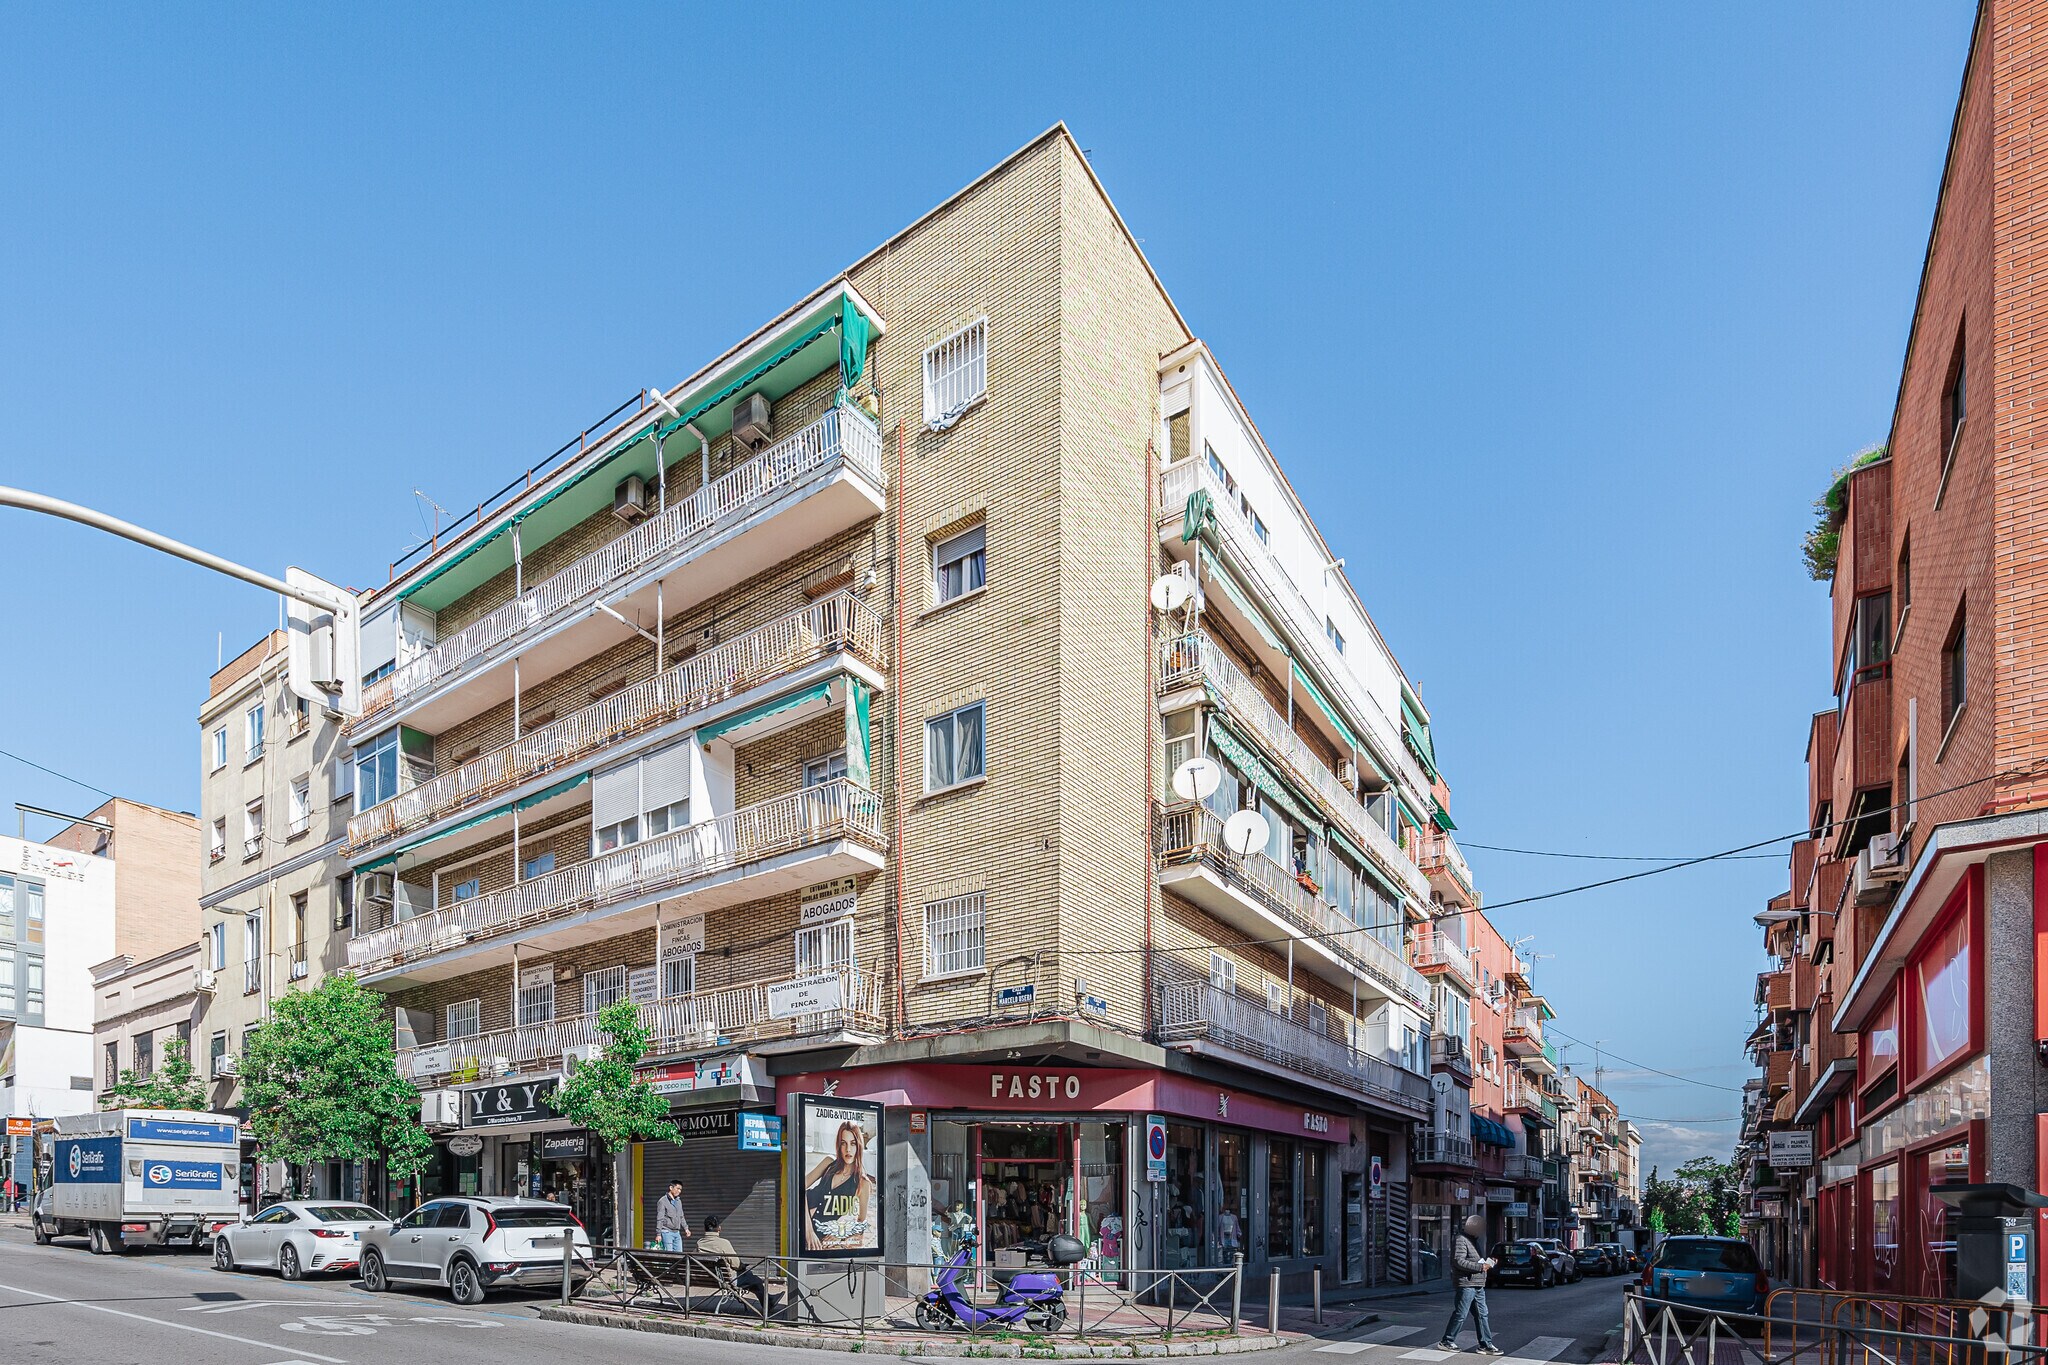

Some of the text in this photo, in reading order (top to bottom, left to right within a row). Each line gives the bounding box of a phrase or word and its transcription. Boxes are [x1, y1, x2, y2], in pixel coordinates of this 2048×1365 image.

[803, 897, 855, 919] ABOGADOS
[671, 934, 690, 943] FINCAS
[662, 941, 701, 958] ABOGADOS
[770, 974, 838, 993] ADMINISTRACIÓN
[790, 999, 818, 1009] FINCAS
[1000, 994, 1032, 1004] MARCELO USERA
[991, 1074, 1080, 1099] FASTO
[471, 1090, 488, 1114] Y
[496, 1088, 513, 1112] &
[522, 1084, 539, 1109] Y
[745, 1118, 780, 1130] REPARAMOS
[1304, 1112, 1328, 1133] FASTO
[156, 1127, 210, 1136] www.serigrafic.net
[752, 1130, 759, 1139] TU
[544, 1136, 584, 1149] Zapatería
[82, 1151, 104, 1164] SeriGrafic
[175, 1169, 217, 1179] SeriGrafic
[823, 1195, 860, 1216] ZADIG
[2011, 1236, 2024, 1257] P
